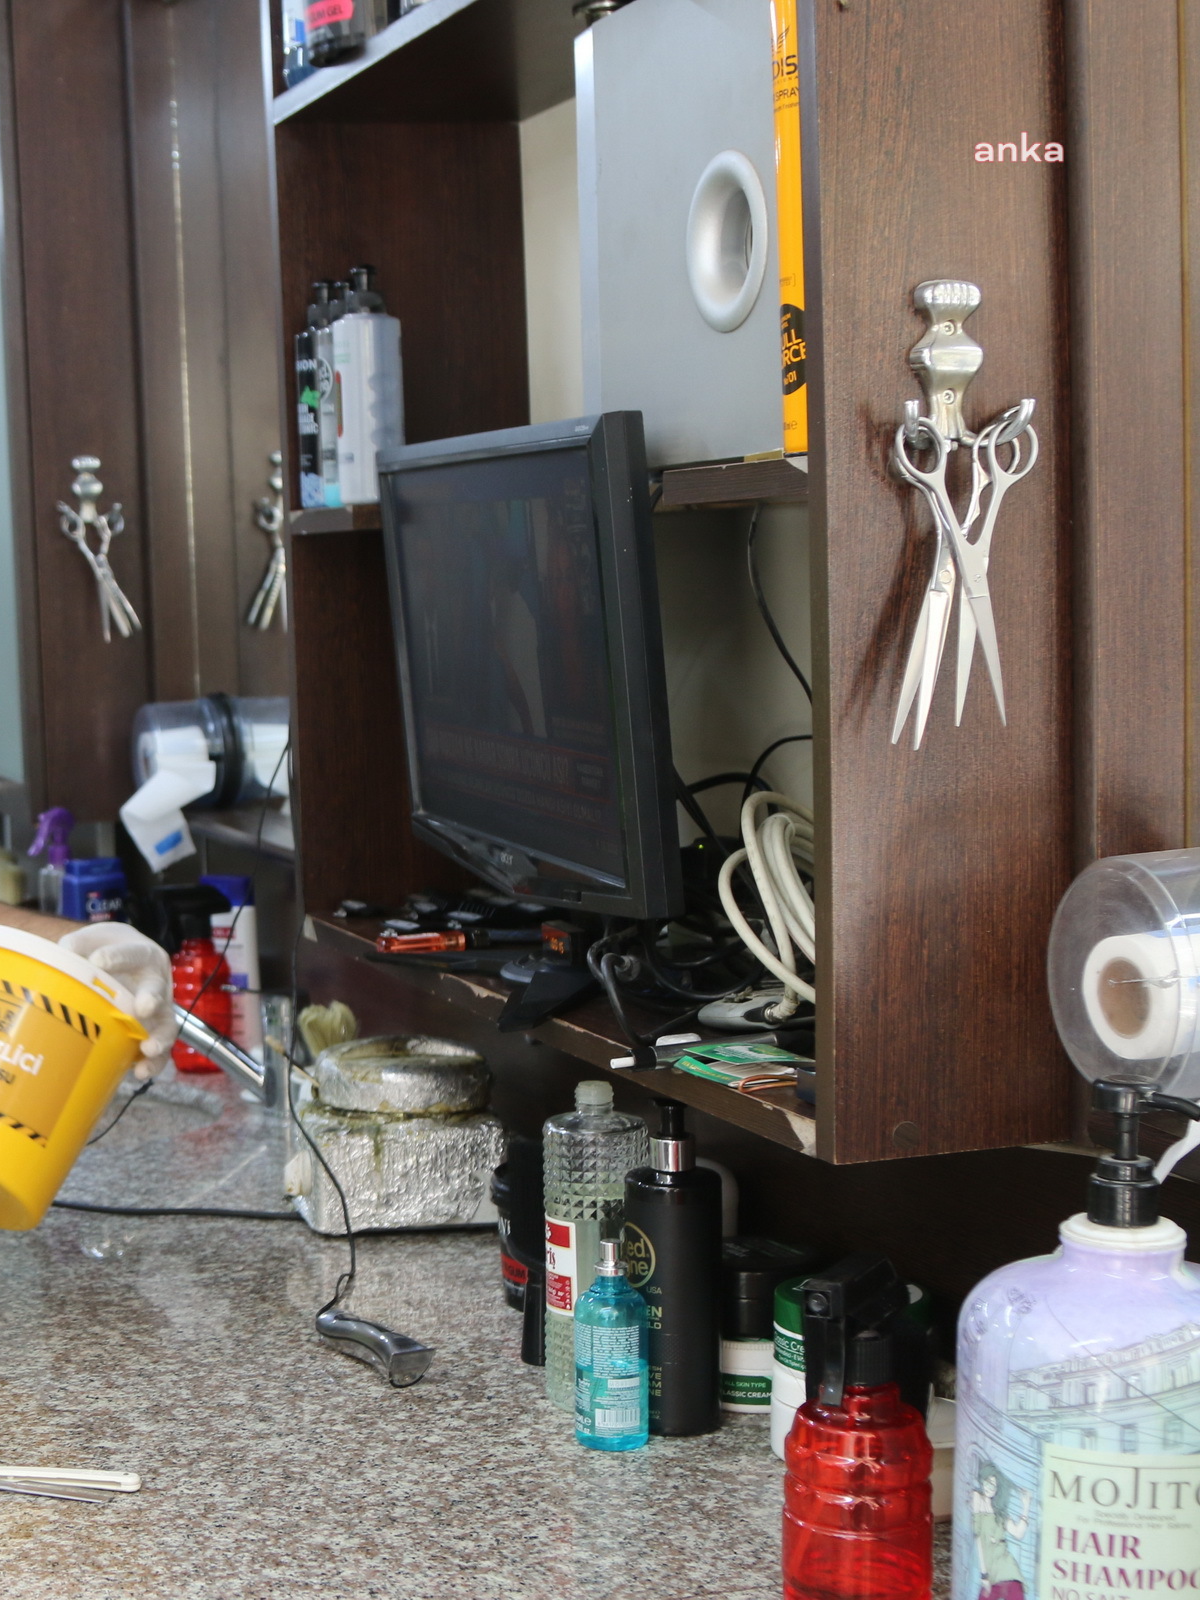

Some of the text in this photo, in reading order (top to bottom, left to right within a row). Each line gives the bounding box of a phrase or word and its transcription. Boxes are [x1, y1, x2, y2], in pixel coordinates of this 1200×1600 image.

[722, 1390, 747, 1398] LASSIC
[1049, 1467, 1200, 1510] MOJIT
[1055, 1526, 1142, 1560] HAIR
